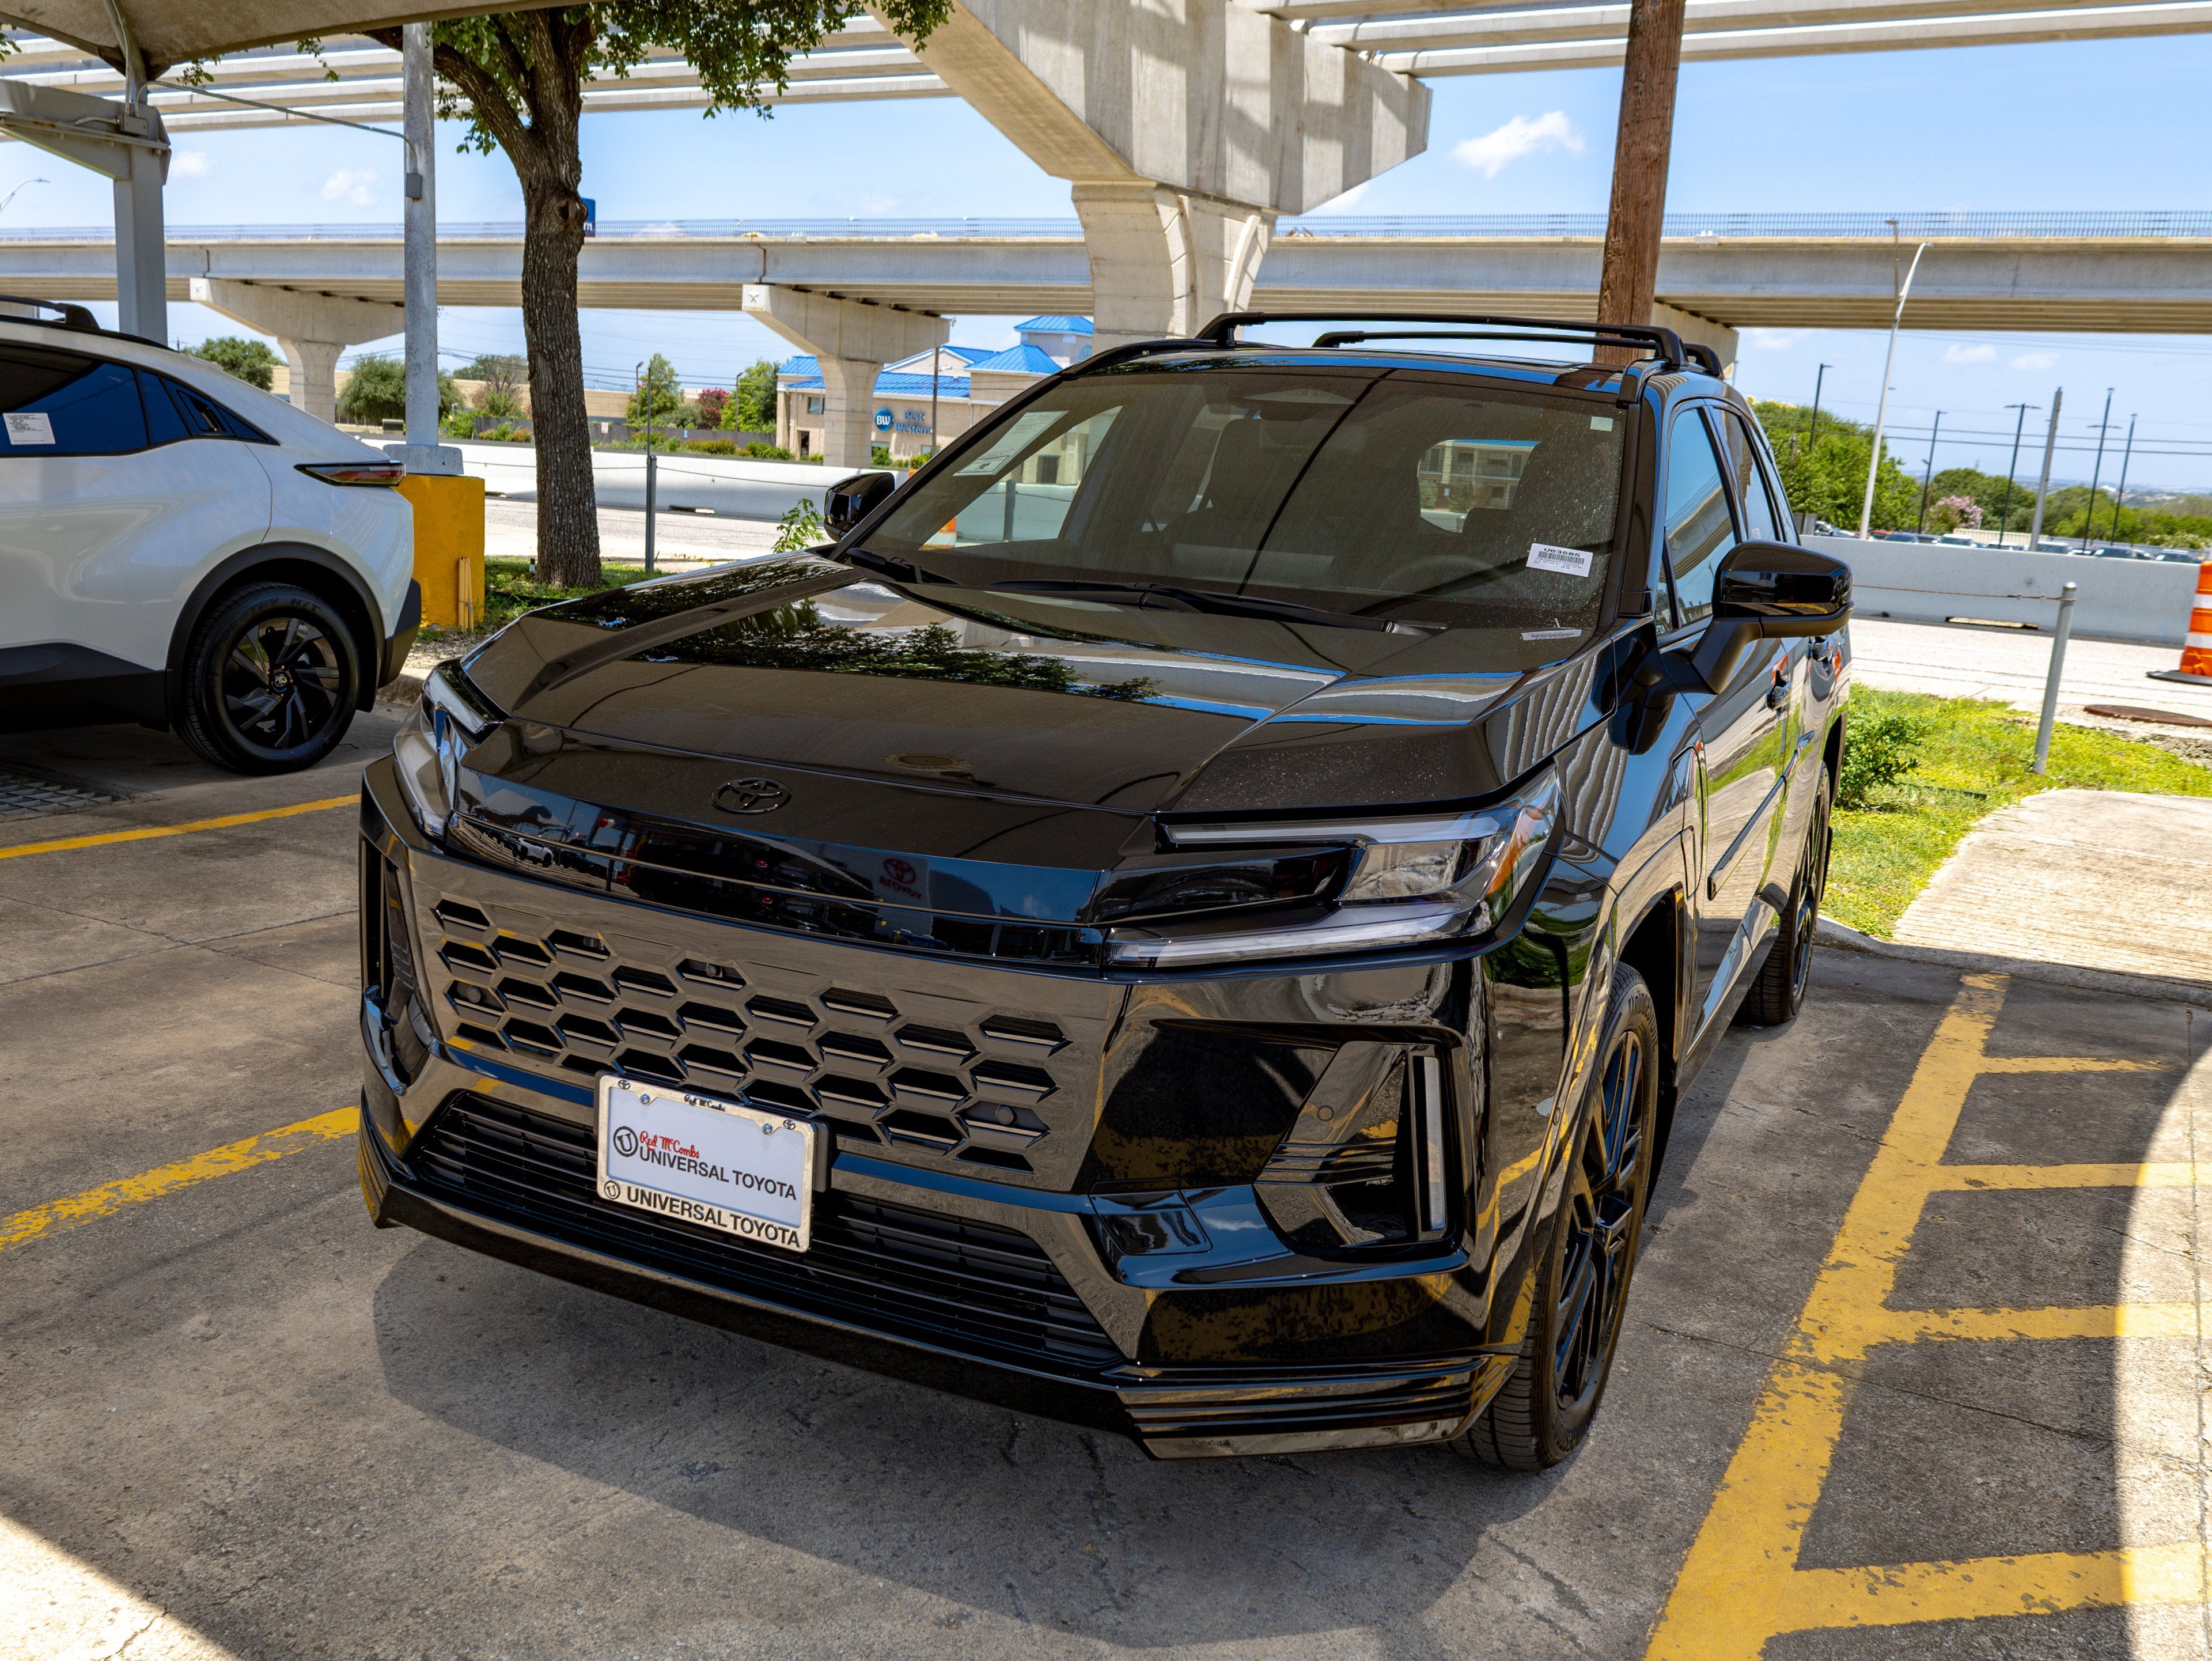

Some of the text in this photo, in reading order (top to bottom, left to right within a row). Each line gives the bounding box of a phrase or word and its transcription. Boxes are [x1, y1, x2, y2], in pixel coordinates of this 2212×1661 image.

[876, 415, 891, 425] BW
[903, 411, 923, 422] Best
[894, 422, 931, 435] Western
[639, 1131, 700, 1159] Red McCombs
[640, 1147, 797, 1201] UNIVERSAL TOYOTA
[627, 1186, 801, 1248] UNIVERSAL TOYOTA
